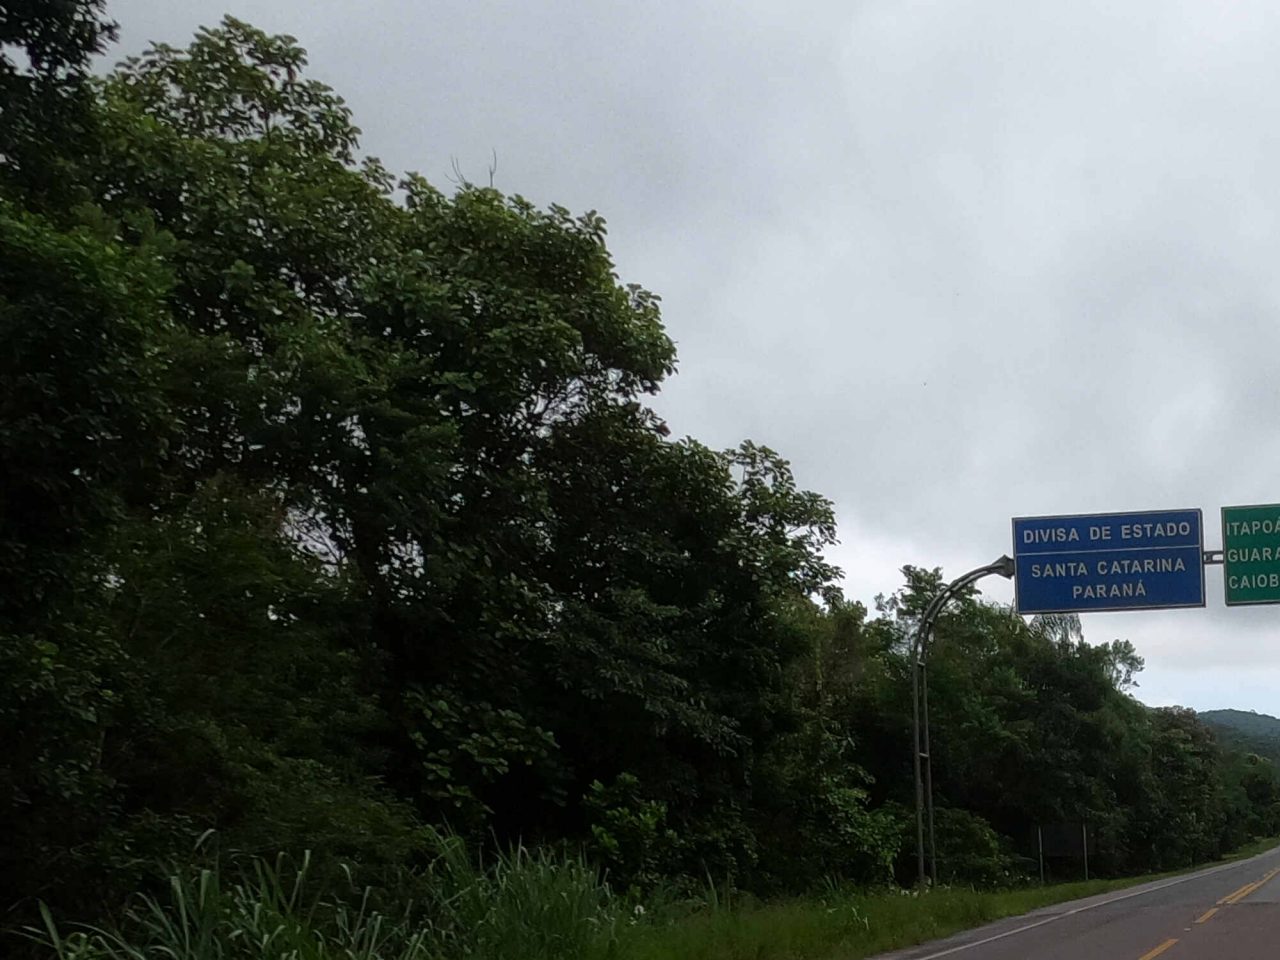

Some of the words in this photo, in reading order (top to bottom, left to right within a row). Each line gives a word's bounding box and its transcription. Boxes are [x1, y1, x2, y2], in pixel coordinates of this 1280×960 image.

[1023, 527, 1080, 544] DIVISA
[1089, 526, 1111, 540] DE
[1121, 522, 1191, 539] ESTADO
[1031, 562, 1088, 578] SANTA
[1097, 558, 1186, 575] CATARINA
[1073, 579, 1147, 599] PARANÁ
